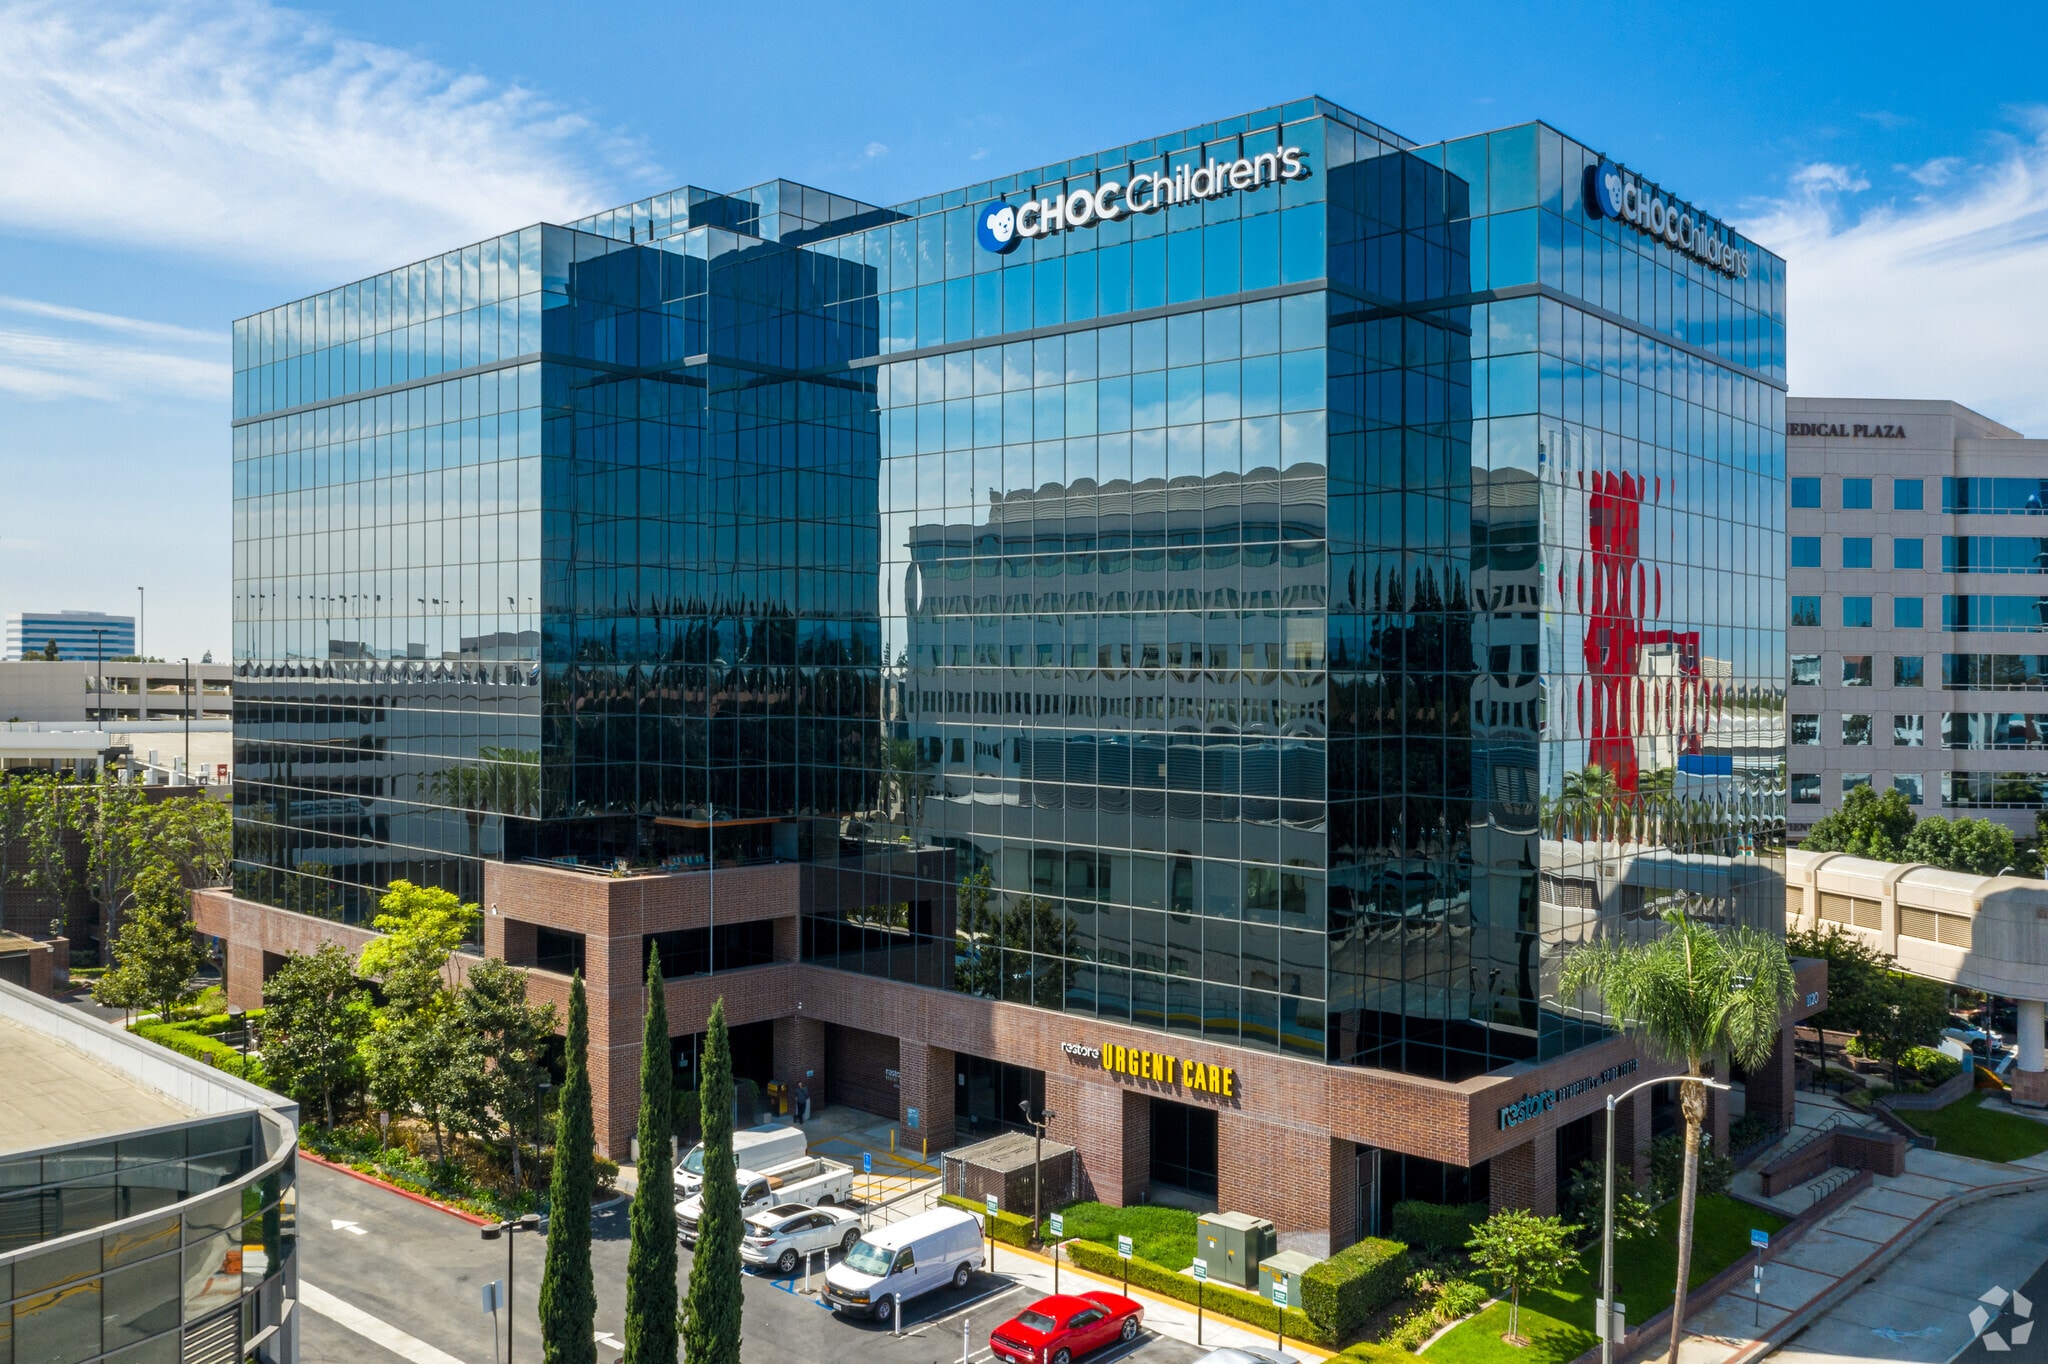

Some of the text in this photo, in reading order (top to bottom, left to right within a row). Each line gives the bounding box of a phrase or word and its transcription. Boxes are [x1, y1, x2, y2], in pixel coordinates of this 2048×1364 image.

[1015, 146, 1302, 238] CHOC Children's
[1622, 182, 1749, 278] CHOC Children's
[1853, 424, 1906, 438] PLAZA
[1061, 1042, 1100, 1059] restore
[1103, 1042, 1233, 1097] URGENT CARE
[1500, 1089, 1556, 1131] restore
